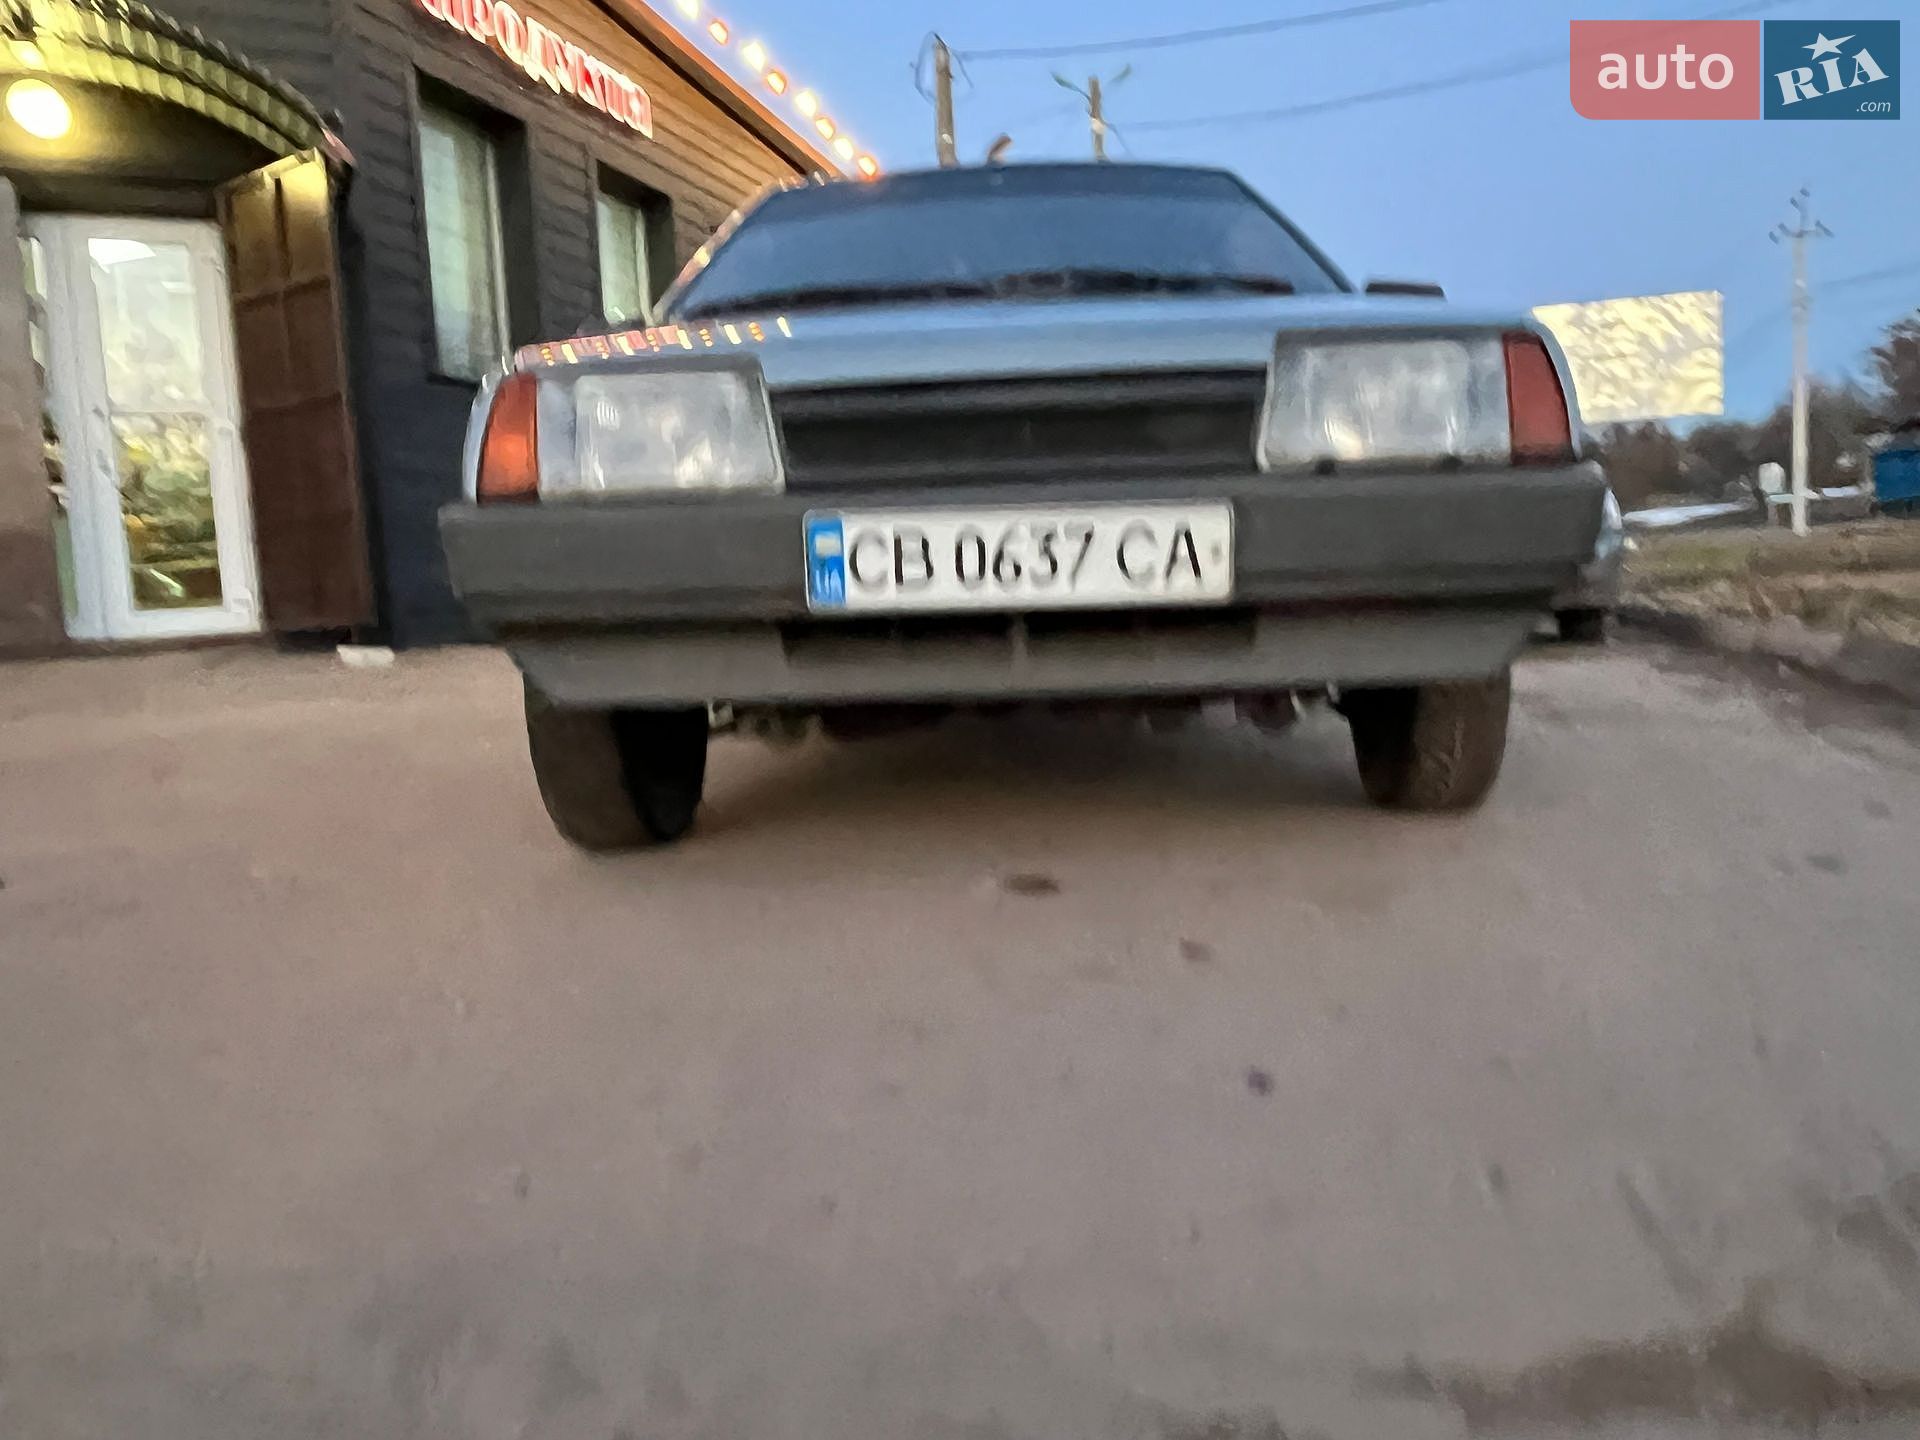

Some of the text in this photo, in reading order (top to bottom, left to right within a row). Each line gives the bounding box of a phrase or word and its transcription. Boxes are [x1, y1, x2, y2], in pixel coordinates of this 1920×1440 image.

[849, 517, 1202, 592] CB 0637 CA
